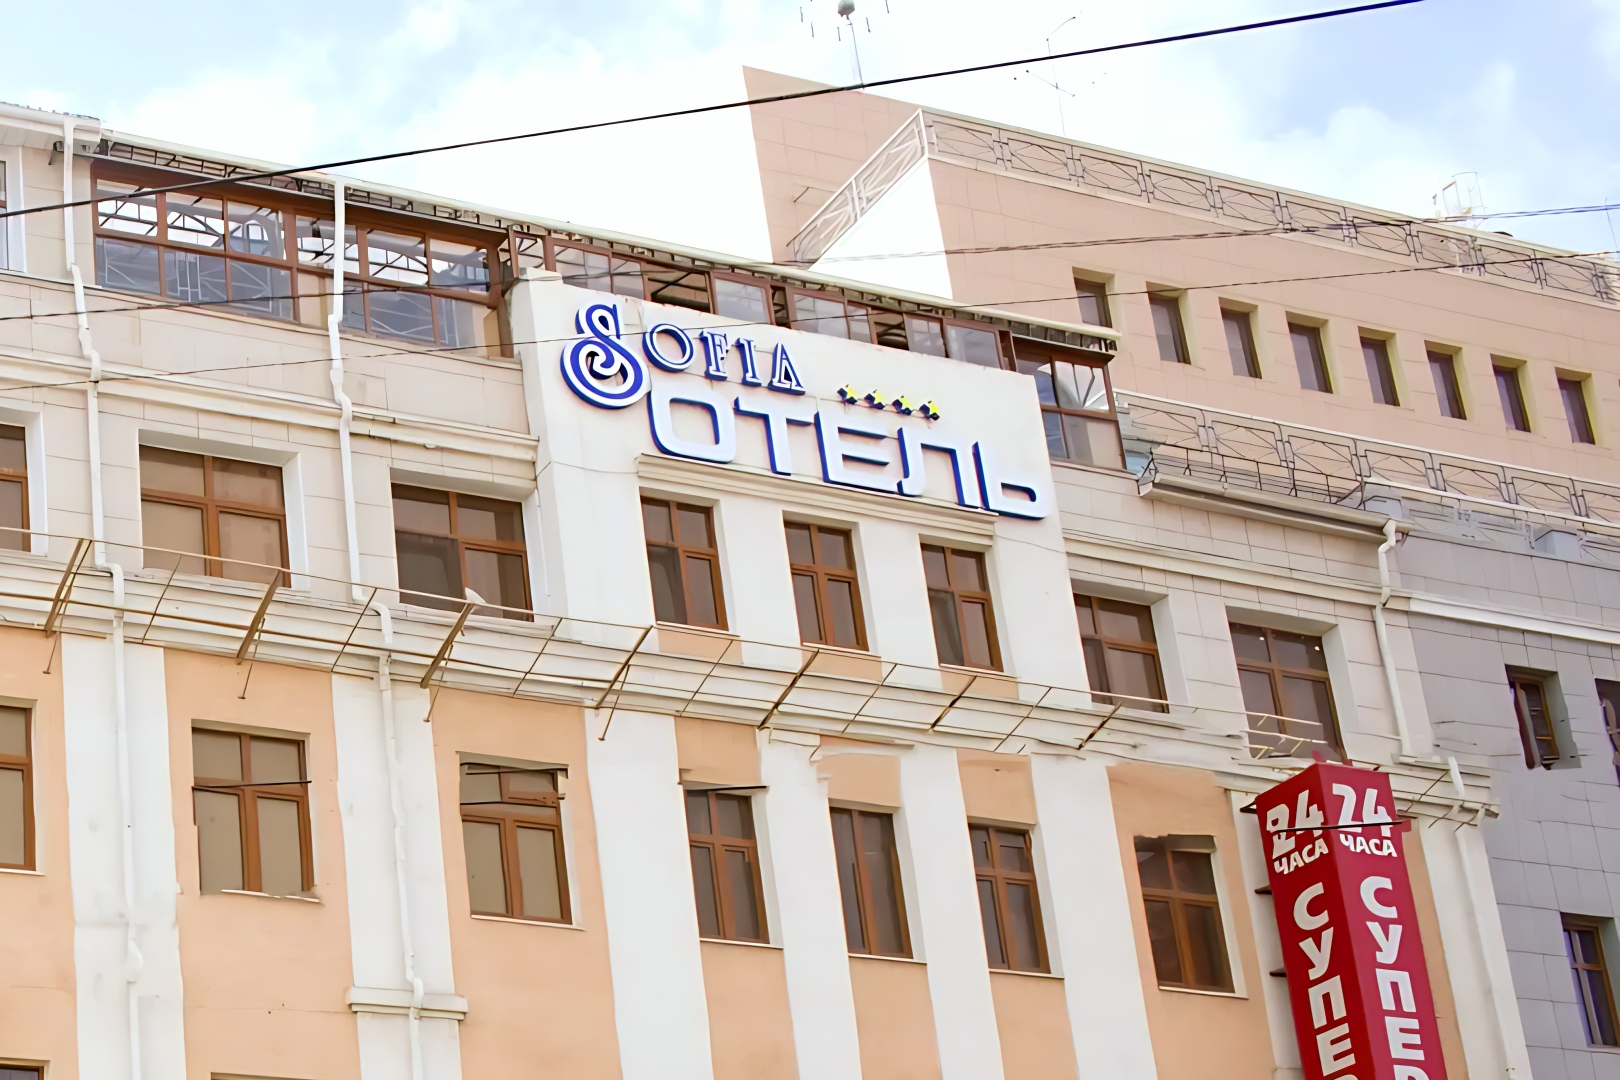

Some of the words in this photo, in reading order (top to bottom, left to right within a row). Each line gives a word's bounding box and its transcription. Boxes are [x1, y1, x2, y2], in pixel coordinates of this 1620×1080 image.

[560, 303, 806, 409] SOFIA
[648, 390, 1052, 521] ОТЕЛЬ
[1332, 782, 1394, 838] 24
[1273, 837, 1329, 875] ЧАСА
[1339, 833, 1398, 858] ЧАСА
